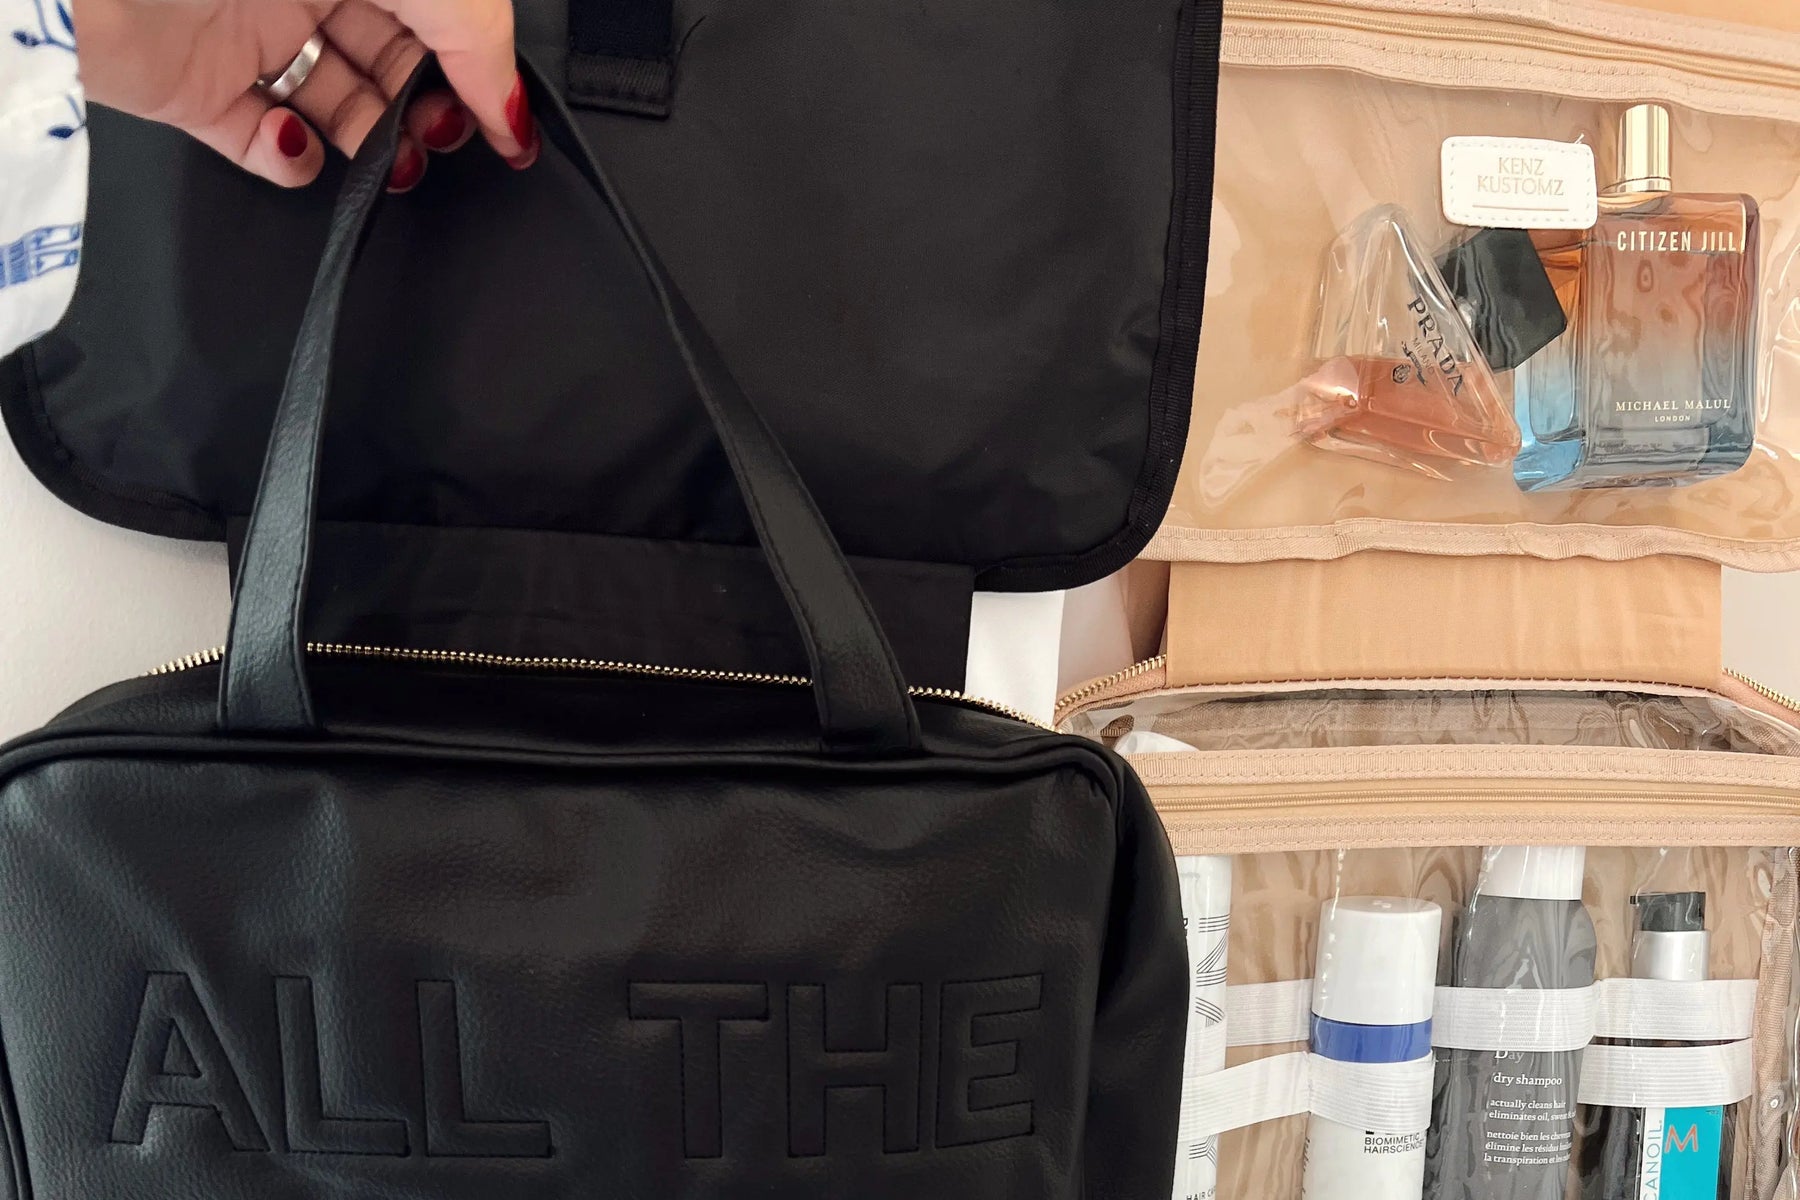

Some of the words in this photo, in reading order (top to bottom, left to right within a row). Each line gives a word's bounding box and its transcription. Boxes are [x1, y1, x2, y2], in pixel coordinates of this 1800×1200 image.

[1498, 157, 1544, 176] KENZ
[1477, 175, 1564, 196] KUSTOMZ
[1617, 231, 1691, 252] CITIZEN
[1701, 231, 1737, 252] JILL
[1407, 296, 1463, 397] PRADA
[1412, 337, 1435, 375] MILANO
[1616, 401, 1679, 411] MICHAEL
[1684, 399, 1732, 409] MALUL
[109, 970, 552, 1159] ALL
[627, 972, 1044, 1159] THE
[1494, 1072, 1514, 1086] dry
[1516, 1074, 1562, 1088] shampoo
[1490, 1099, 1526, 1110] actually
[1528, 1100, 1552, 1109] cleans
[1489, 1110, 1536, 1120] eliminates
[1364, 1132, 1420, 1146] BIOMIMETIC
[1487, 1131, 1519, 1140] nettoie
[1520, 1131, 1539, 1140] bien
[1540, 1132, 1550, 1141] les
[1664, 1124, 1699, 1153] M
[1363, 1139, 1424, 1155] HAIRSCIENCE
[1485, 1141, 1520, 1152] élimine
[1522, 1144, 1534, 1153] les
[1484, 1153, 1492, 1162] la
[1493, 1154, 1548, 1166] transpiration
